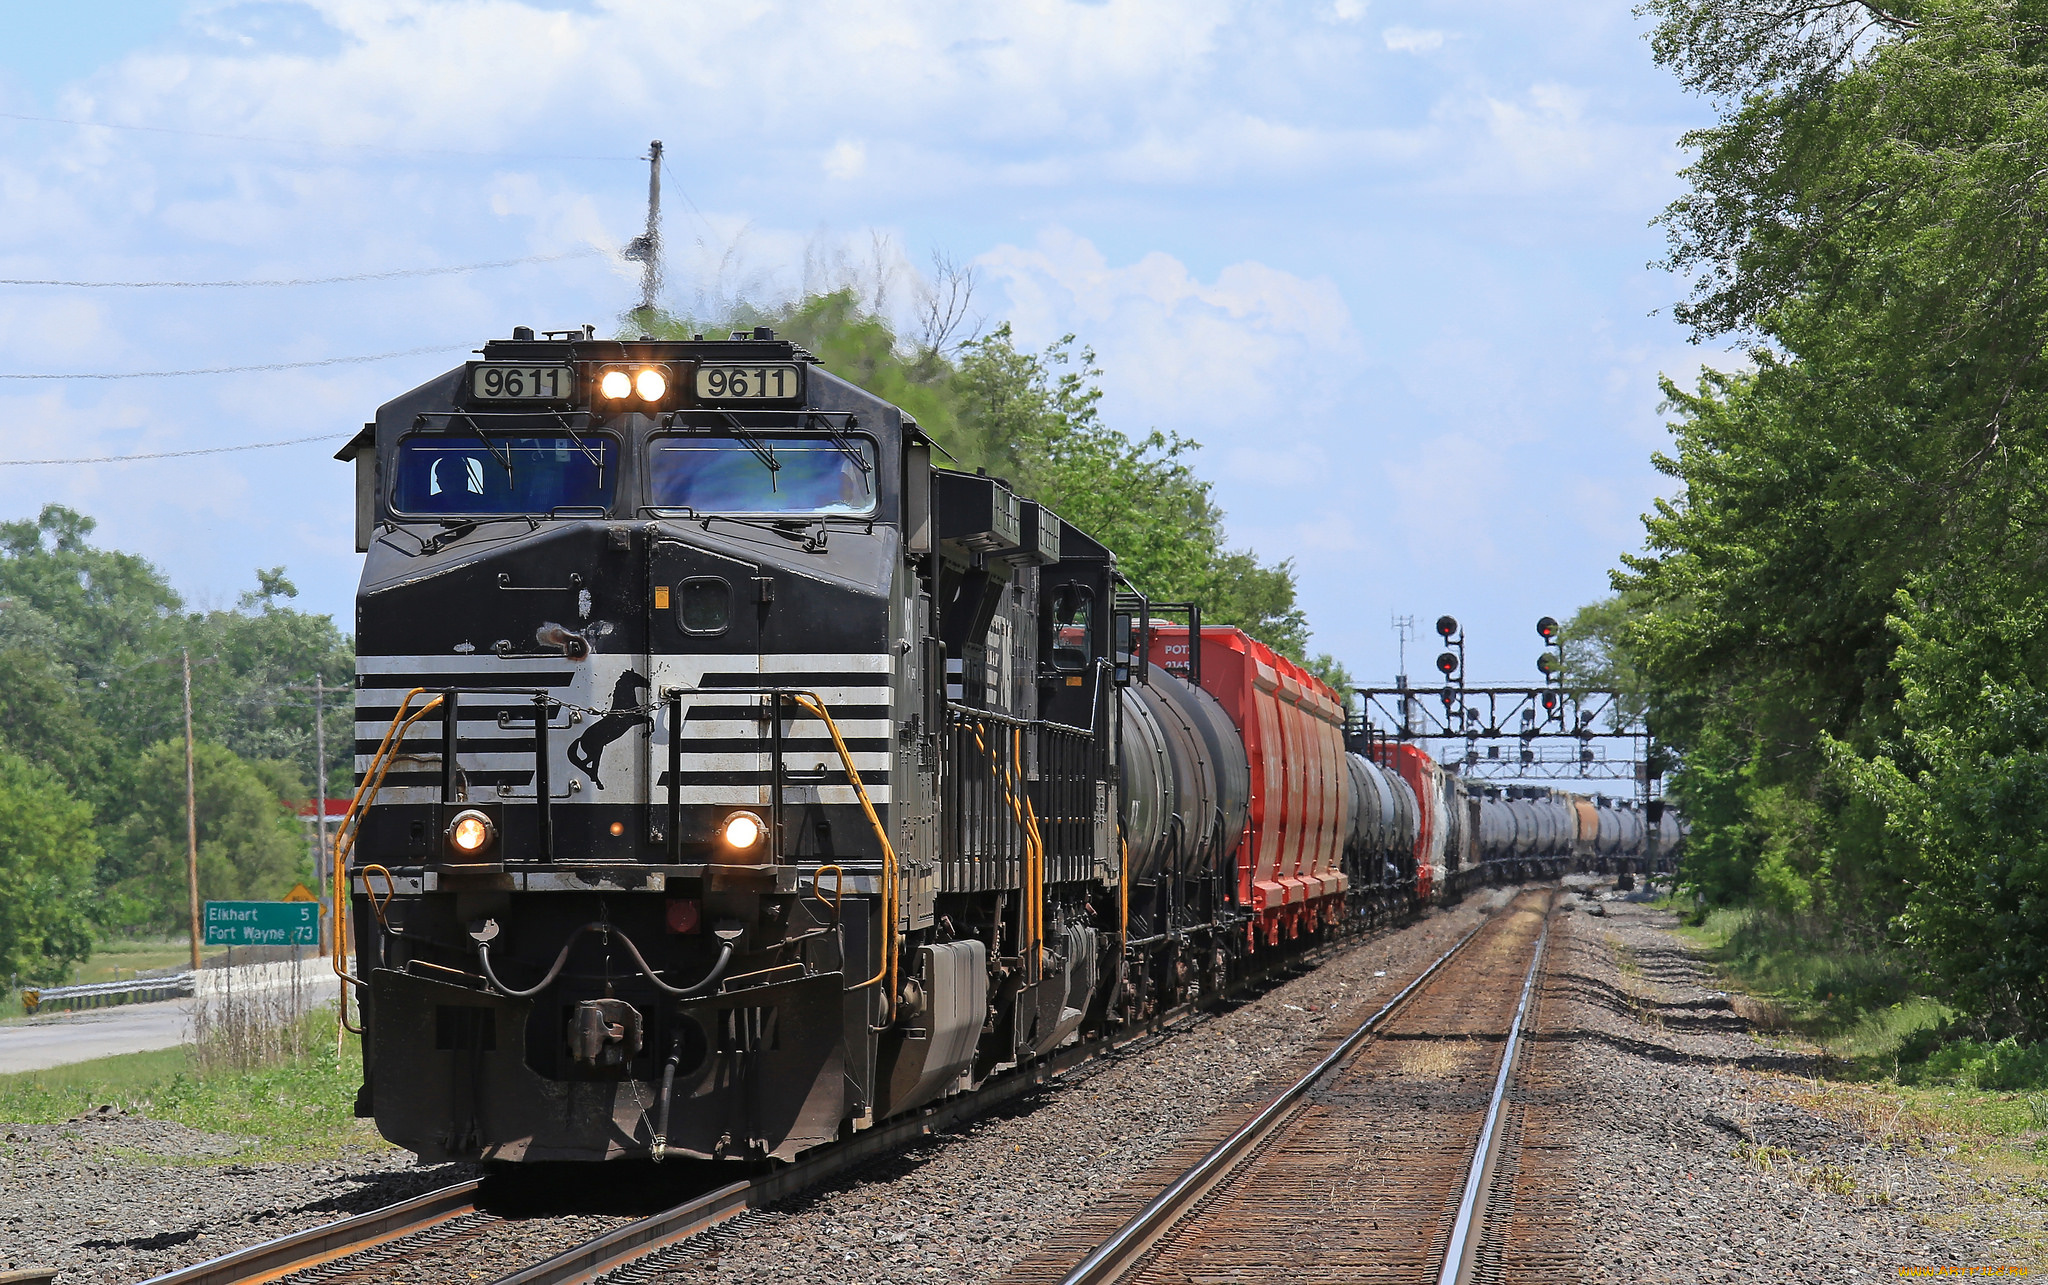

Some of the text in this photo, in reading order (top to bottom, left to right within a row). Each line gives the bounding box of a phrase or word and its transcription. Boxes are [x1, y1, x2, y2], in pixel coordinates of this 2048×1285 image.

[484, 369, 559, 396] 9611
[708, 369, 785, 397] 9611
[1164, 645, 1190, 654] POT
[209, 907, 310, 921] Elkhart 5
[208, 925, 313, 943] Fort Wayne 73
